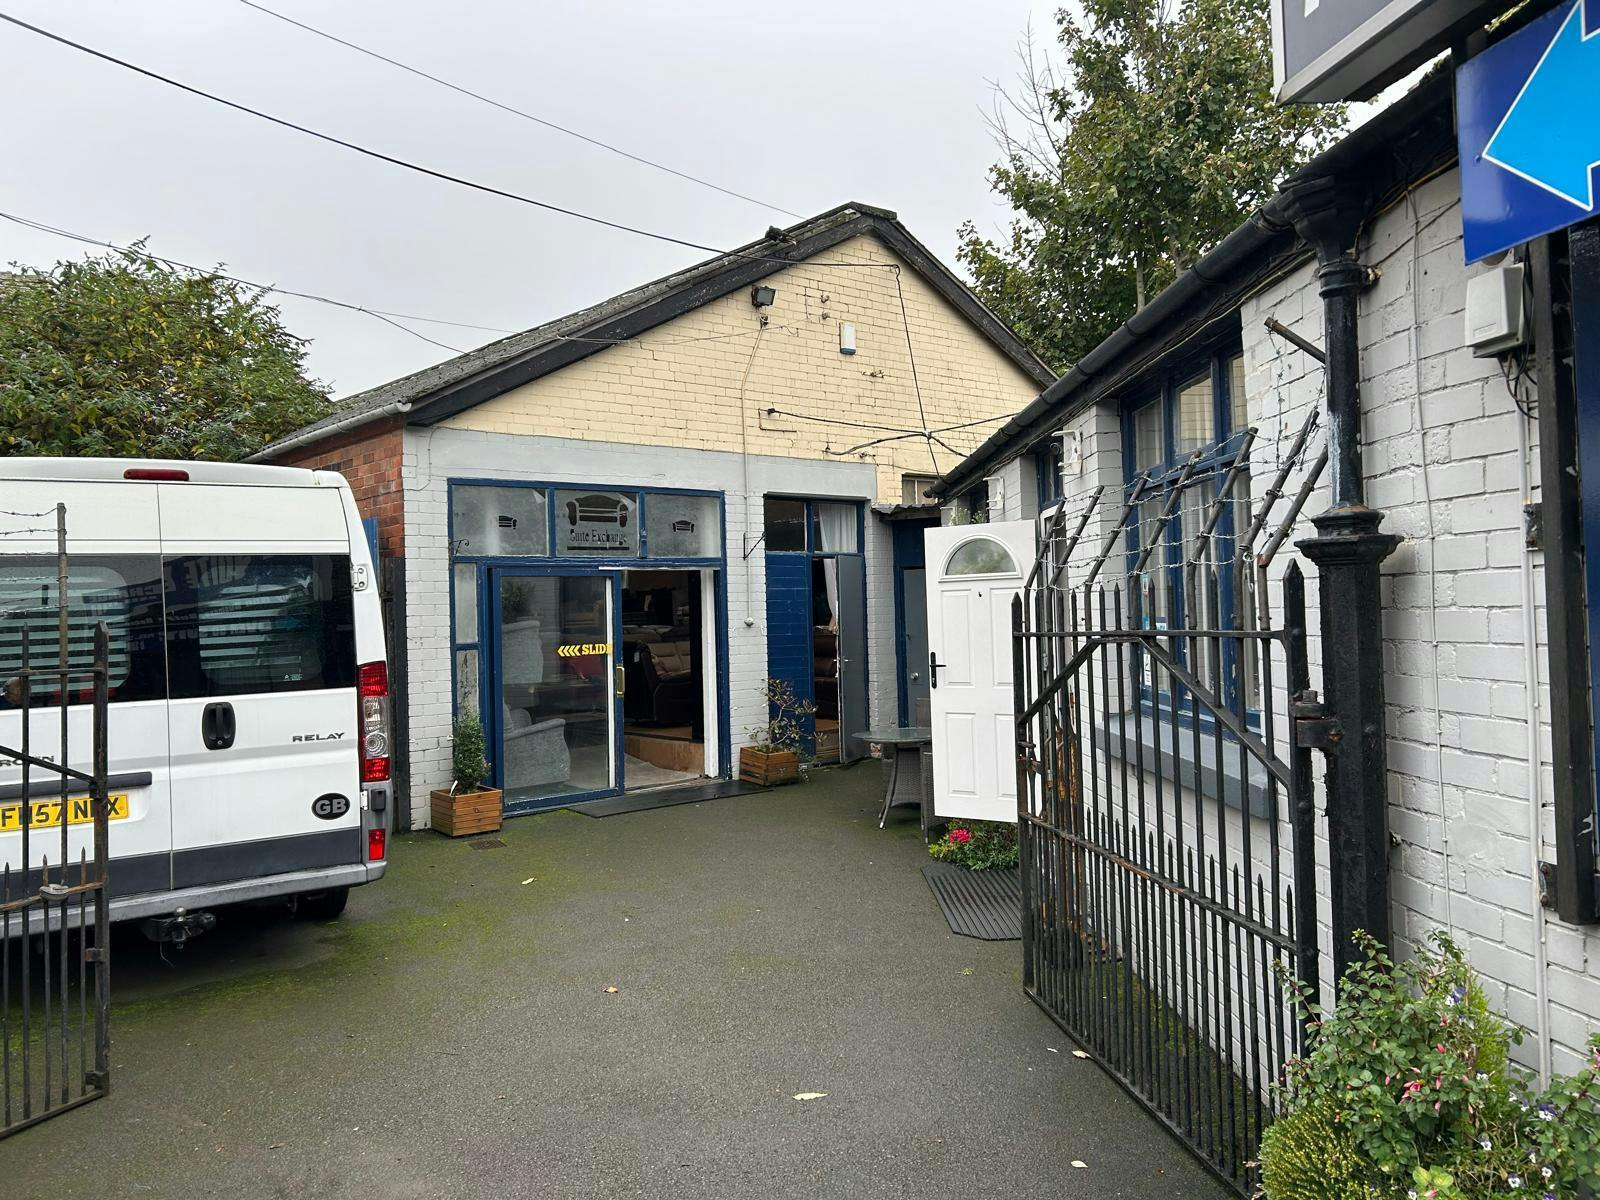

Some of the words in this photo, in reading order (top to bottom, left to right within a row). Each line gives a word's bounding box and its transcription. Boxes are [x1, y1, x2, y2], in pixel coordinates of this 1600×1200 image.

[292, 732, 345, 742] RELAY
[73, 797, 120, 820] NX
[315, 798, 347, 815] GB
